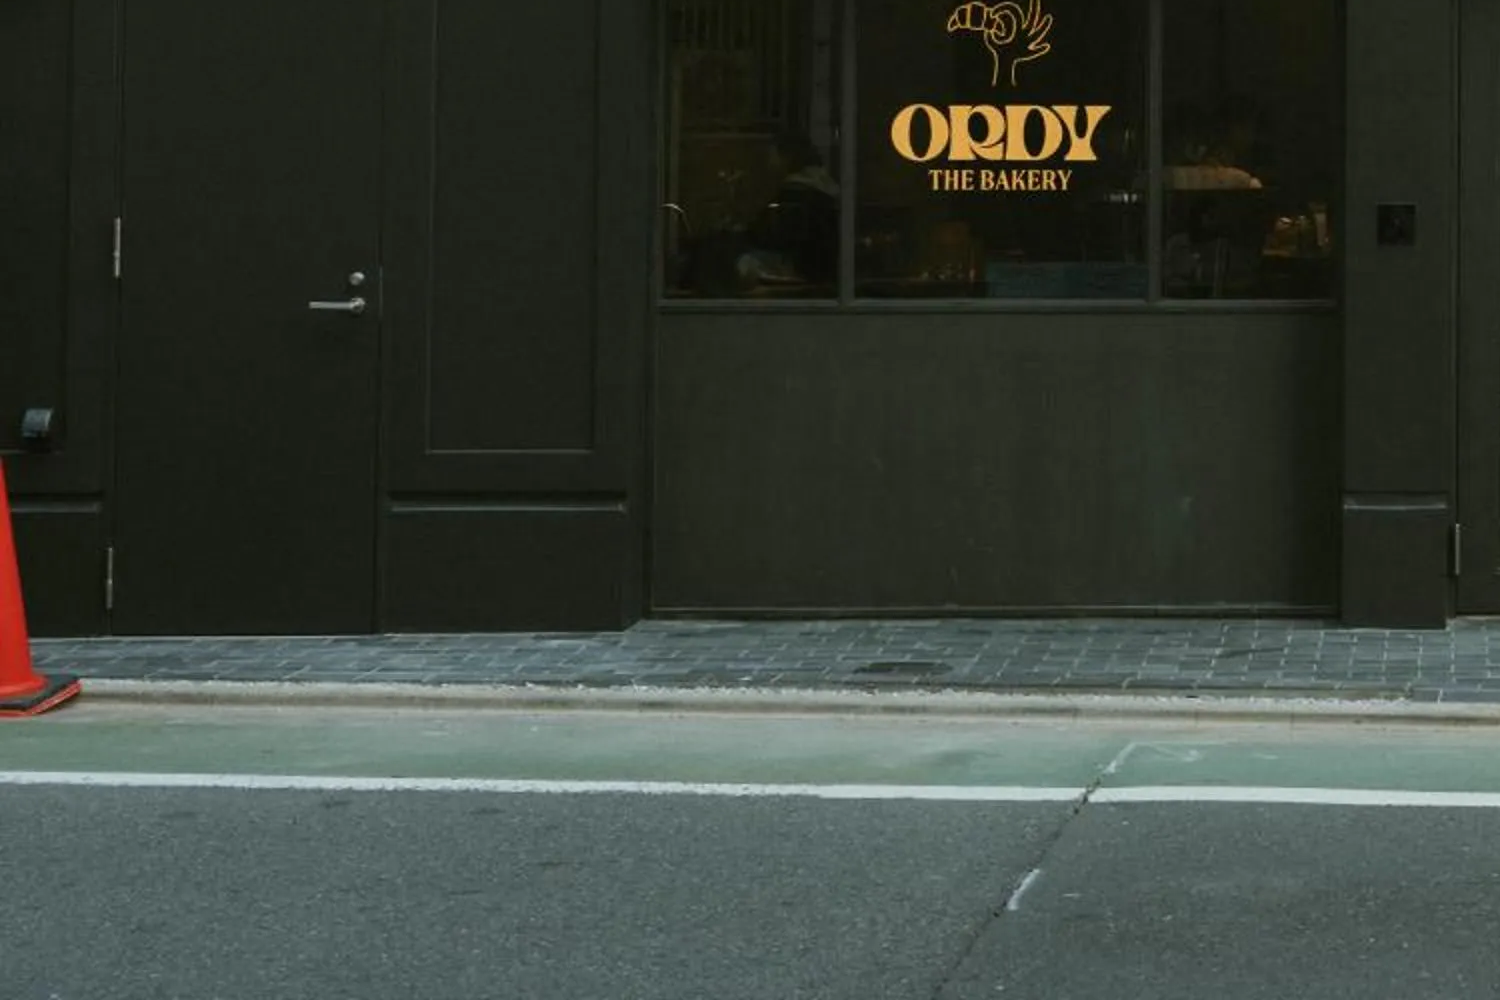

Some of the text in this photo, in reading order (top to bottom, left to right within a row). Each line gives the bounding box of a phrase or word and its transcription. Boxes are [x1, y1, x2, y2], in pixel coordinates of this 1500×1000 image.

[890, 103, 1112, 162] ORDY
[928, 169, 1073, 191] THE BAKERY
